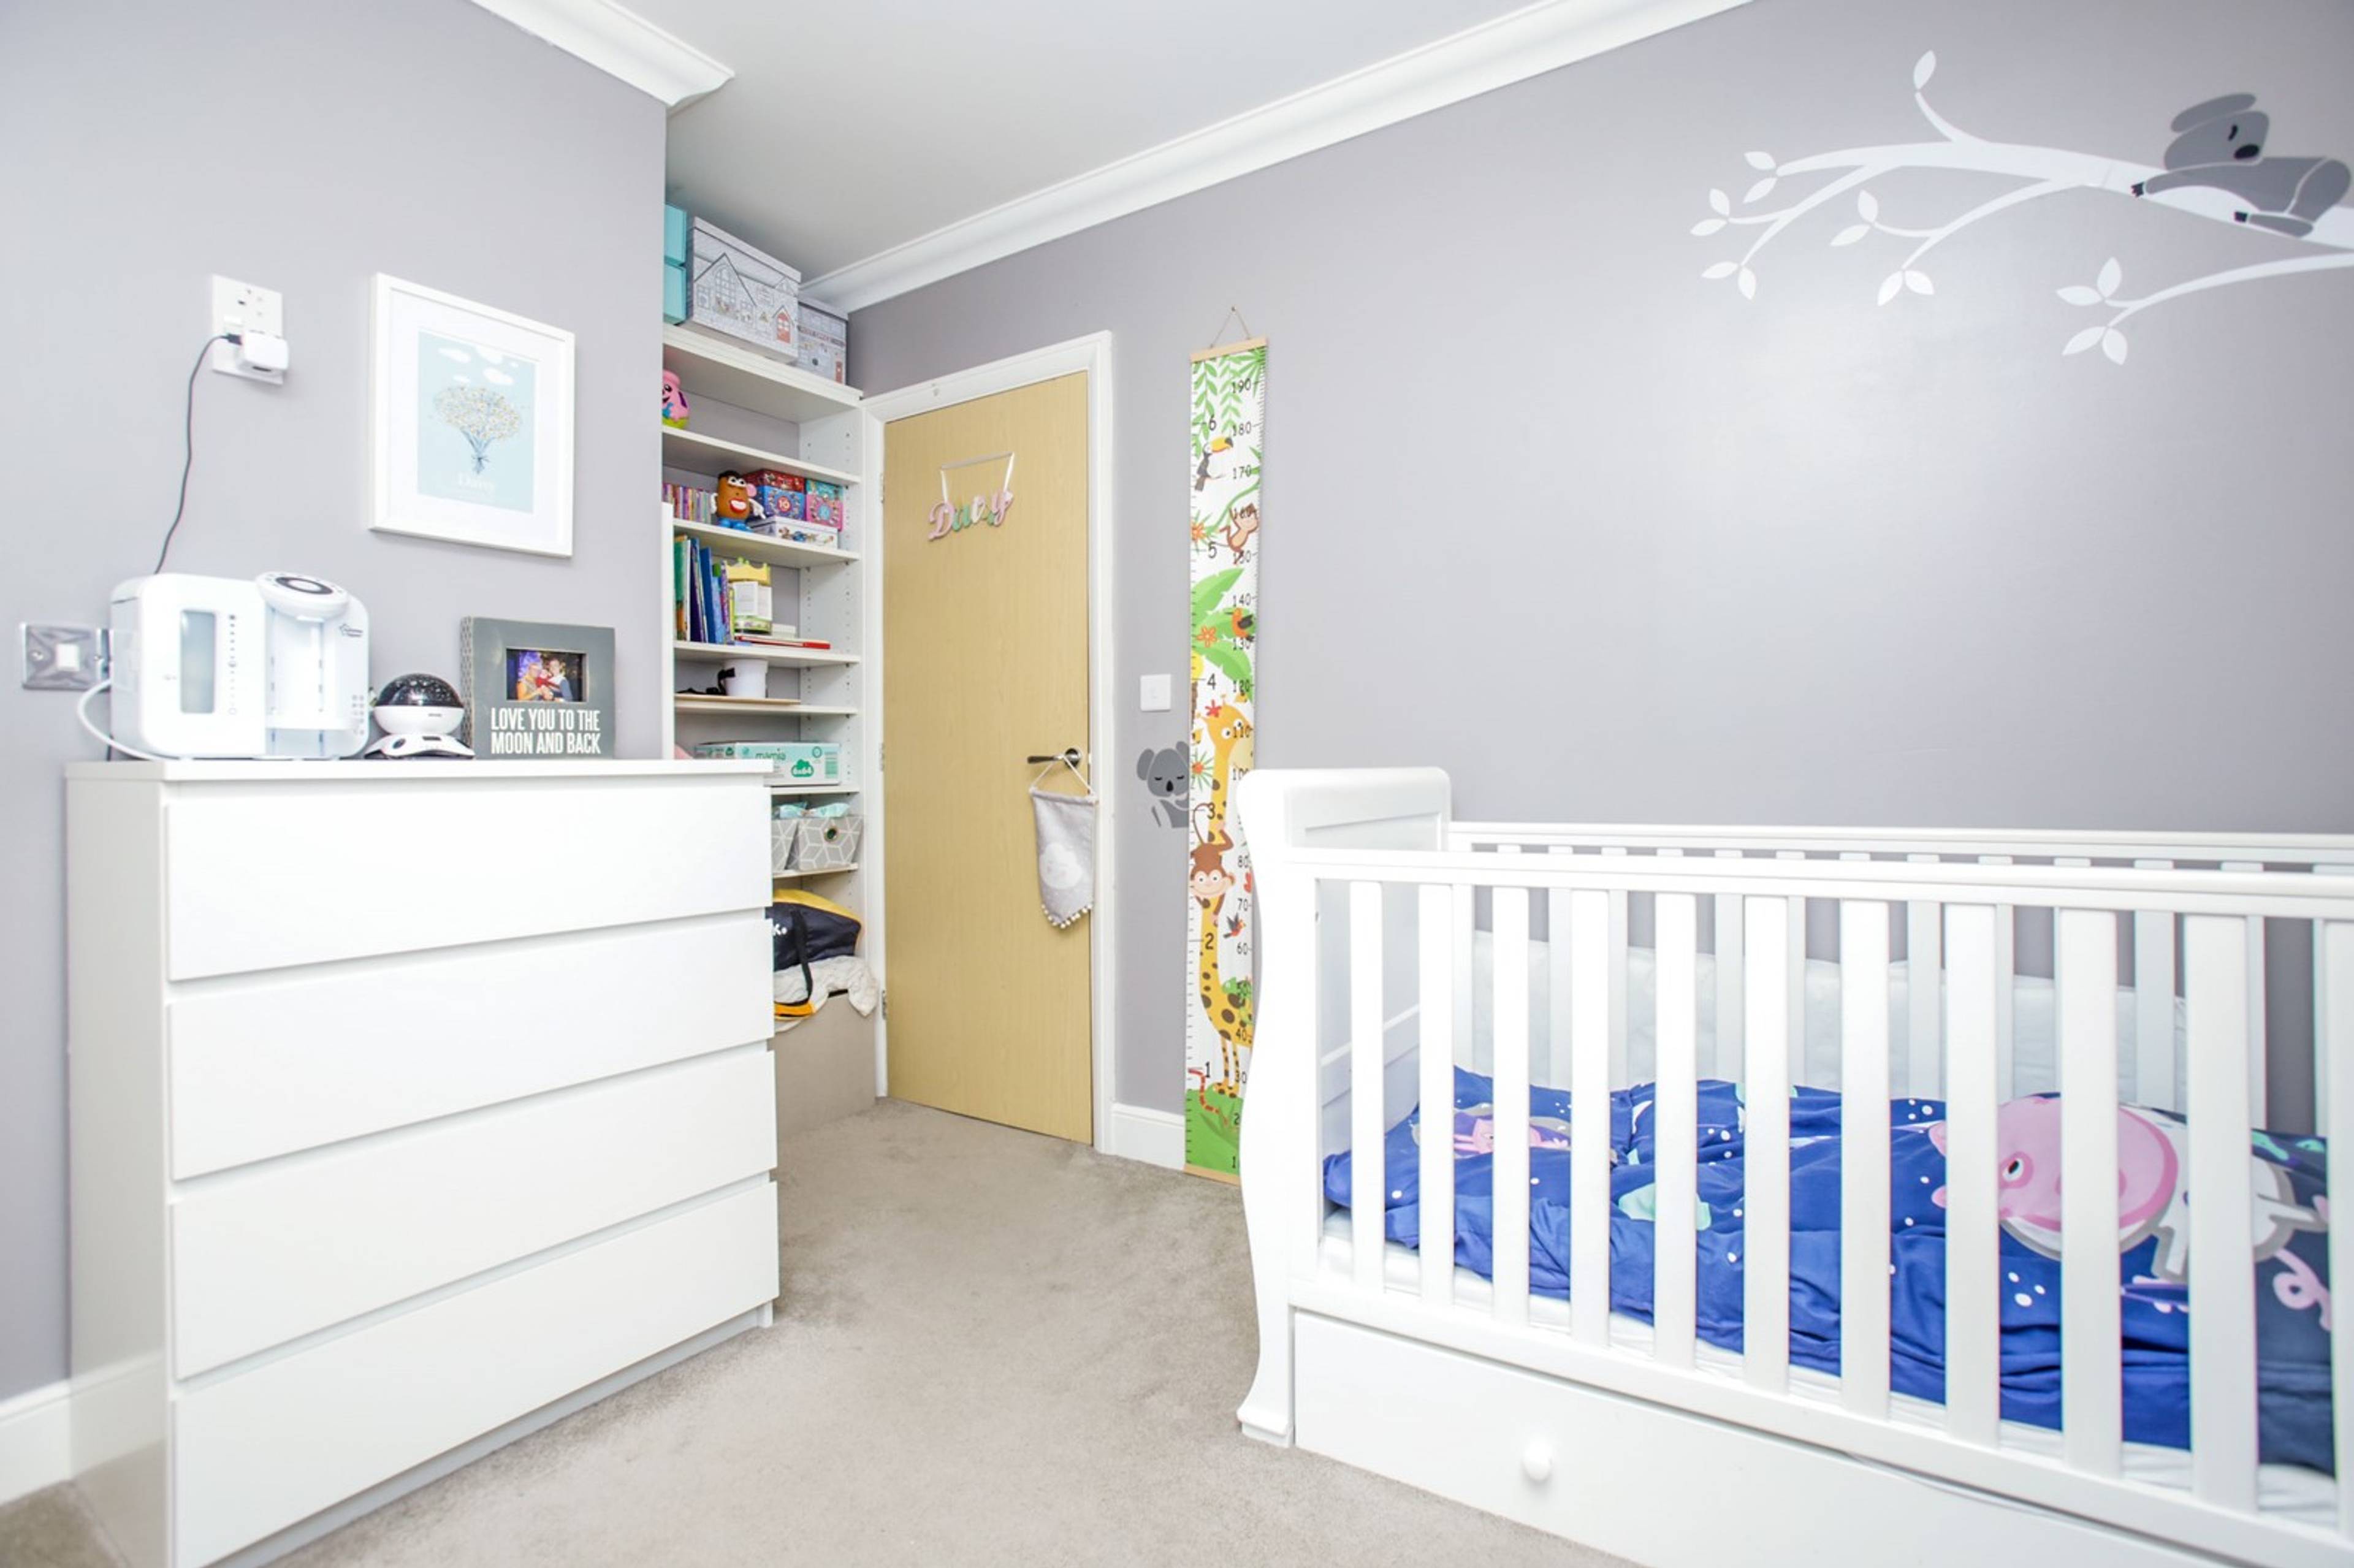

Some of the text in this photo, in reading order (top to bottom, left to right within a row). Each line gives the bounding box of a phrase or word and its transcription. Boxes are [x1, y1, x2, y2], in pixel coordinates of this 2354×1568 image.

[1232, 378, 1251, 393] 190
[1209, 414, 1216, 431] 6
[1233, 422, 1251, 436] 180
[1233, 465, 1251, 480] 170
[1208, 541, 1216, 558] 5
[1233, 593, 1250, 607] 140
[1206, 673, 1216, 690] 4
[1233, 679, 1249, 694] 120
[491, 707, 600, 731] LOVE YOU TO THE
[491, 732, 601, 754] MOON AND BACK
[1207, 802, 1215, 820] 3
[1238, 898, 1248, 911] 70
[1205, 932, 1214, 950] 2
[1236, 942, 1248, 955] 60
[1235, 1028, 1247, 1041] 40
[1205, 1062, 1210, 1078] 1
